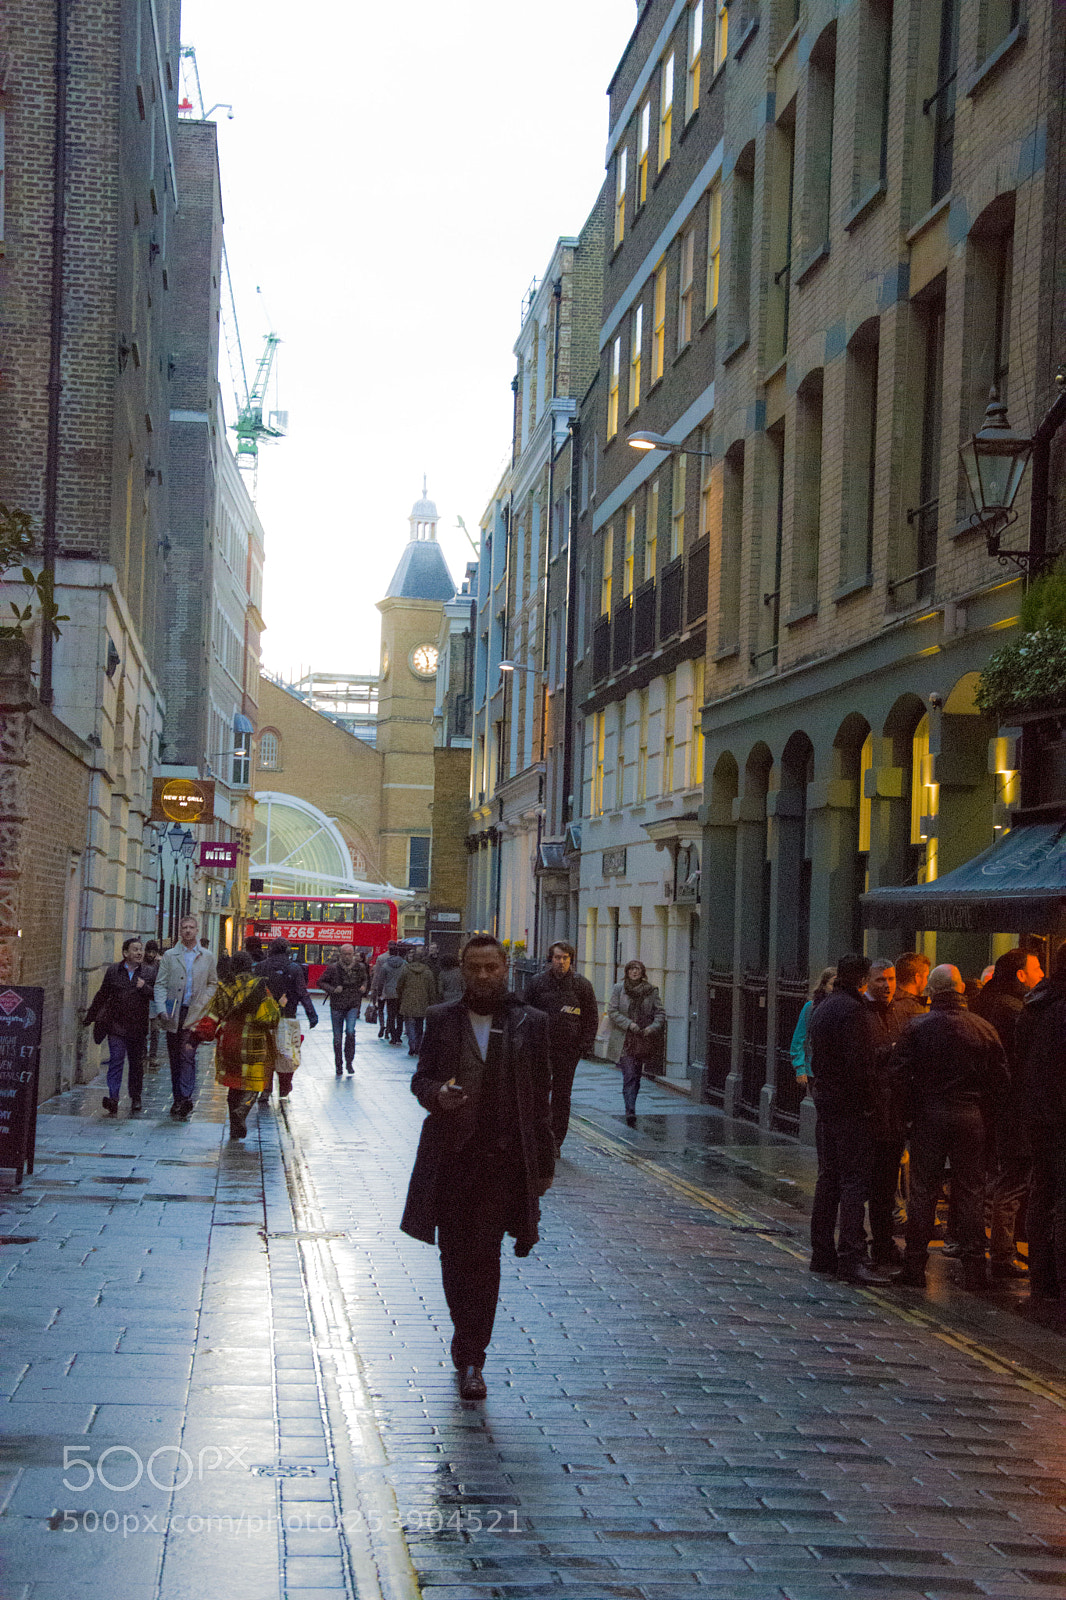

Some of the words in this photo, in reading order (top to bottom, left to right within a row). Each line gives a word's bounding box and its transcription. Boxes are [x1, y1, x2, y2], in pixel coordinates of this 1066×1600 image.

[206, 851, 231, 860] WINE
[288, 926, 315, 938] £65
[318, 927, 352, 935] Jet2.com
